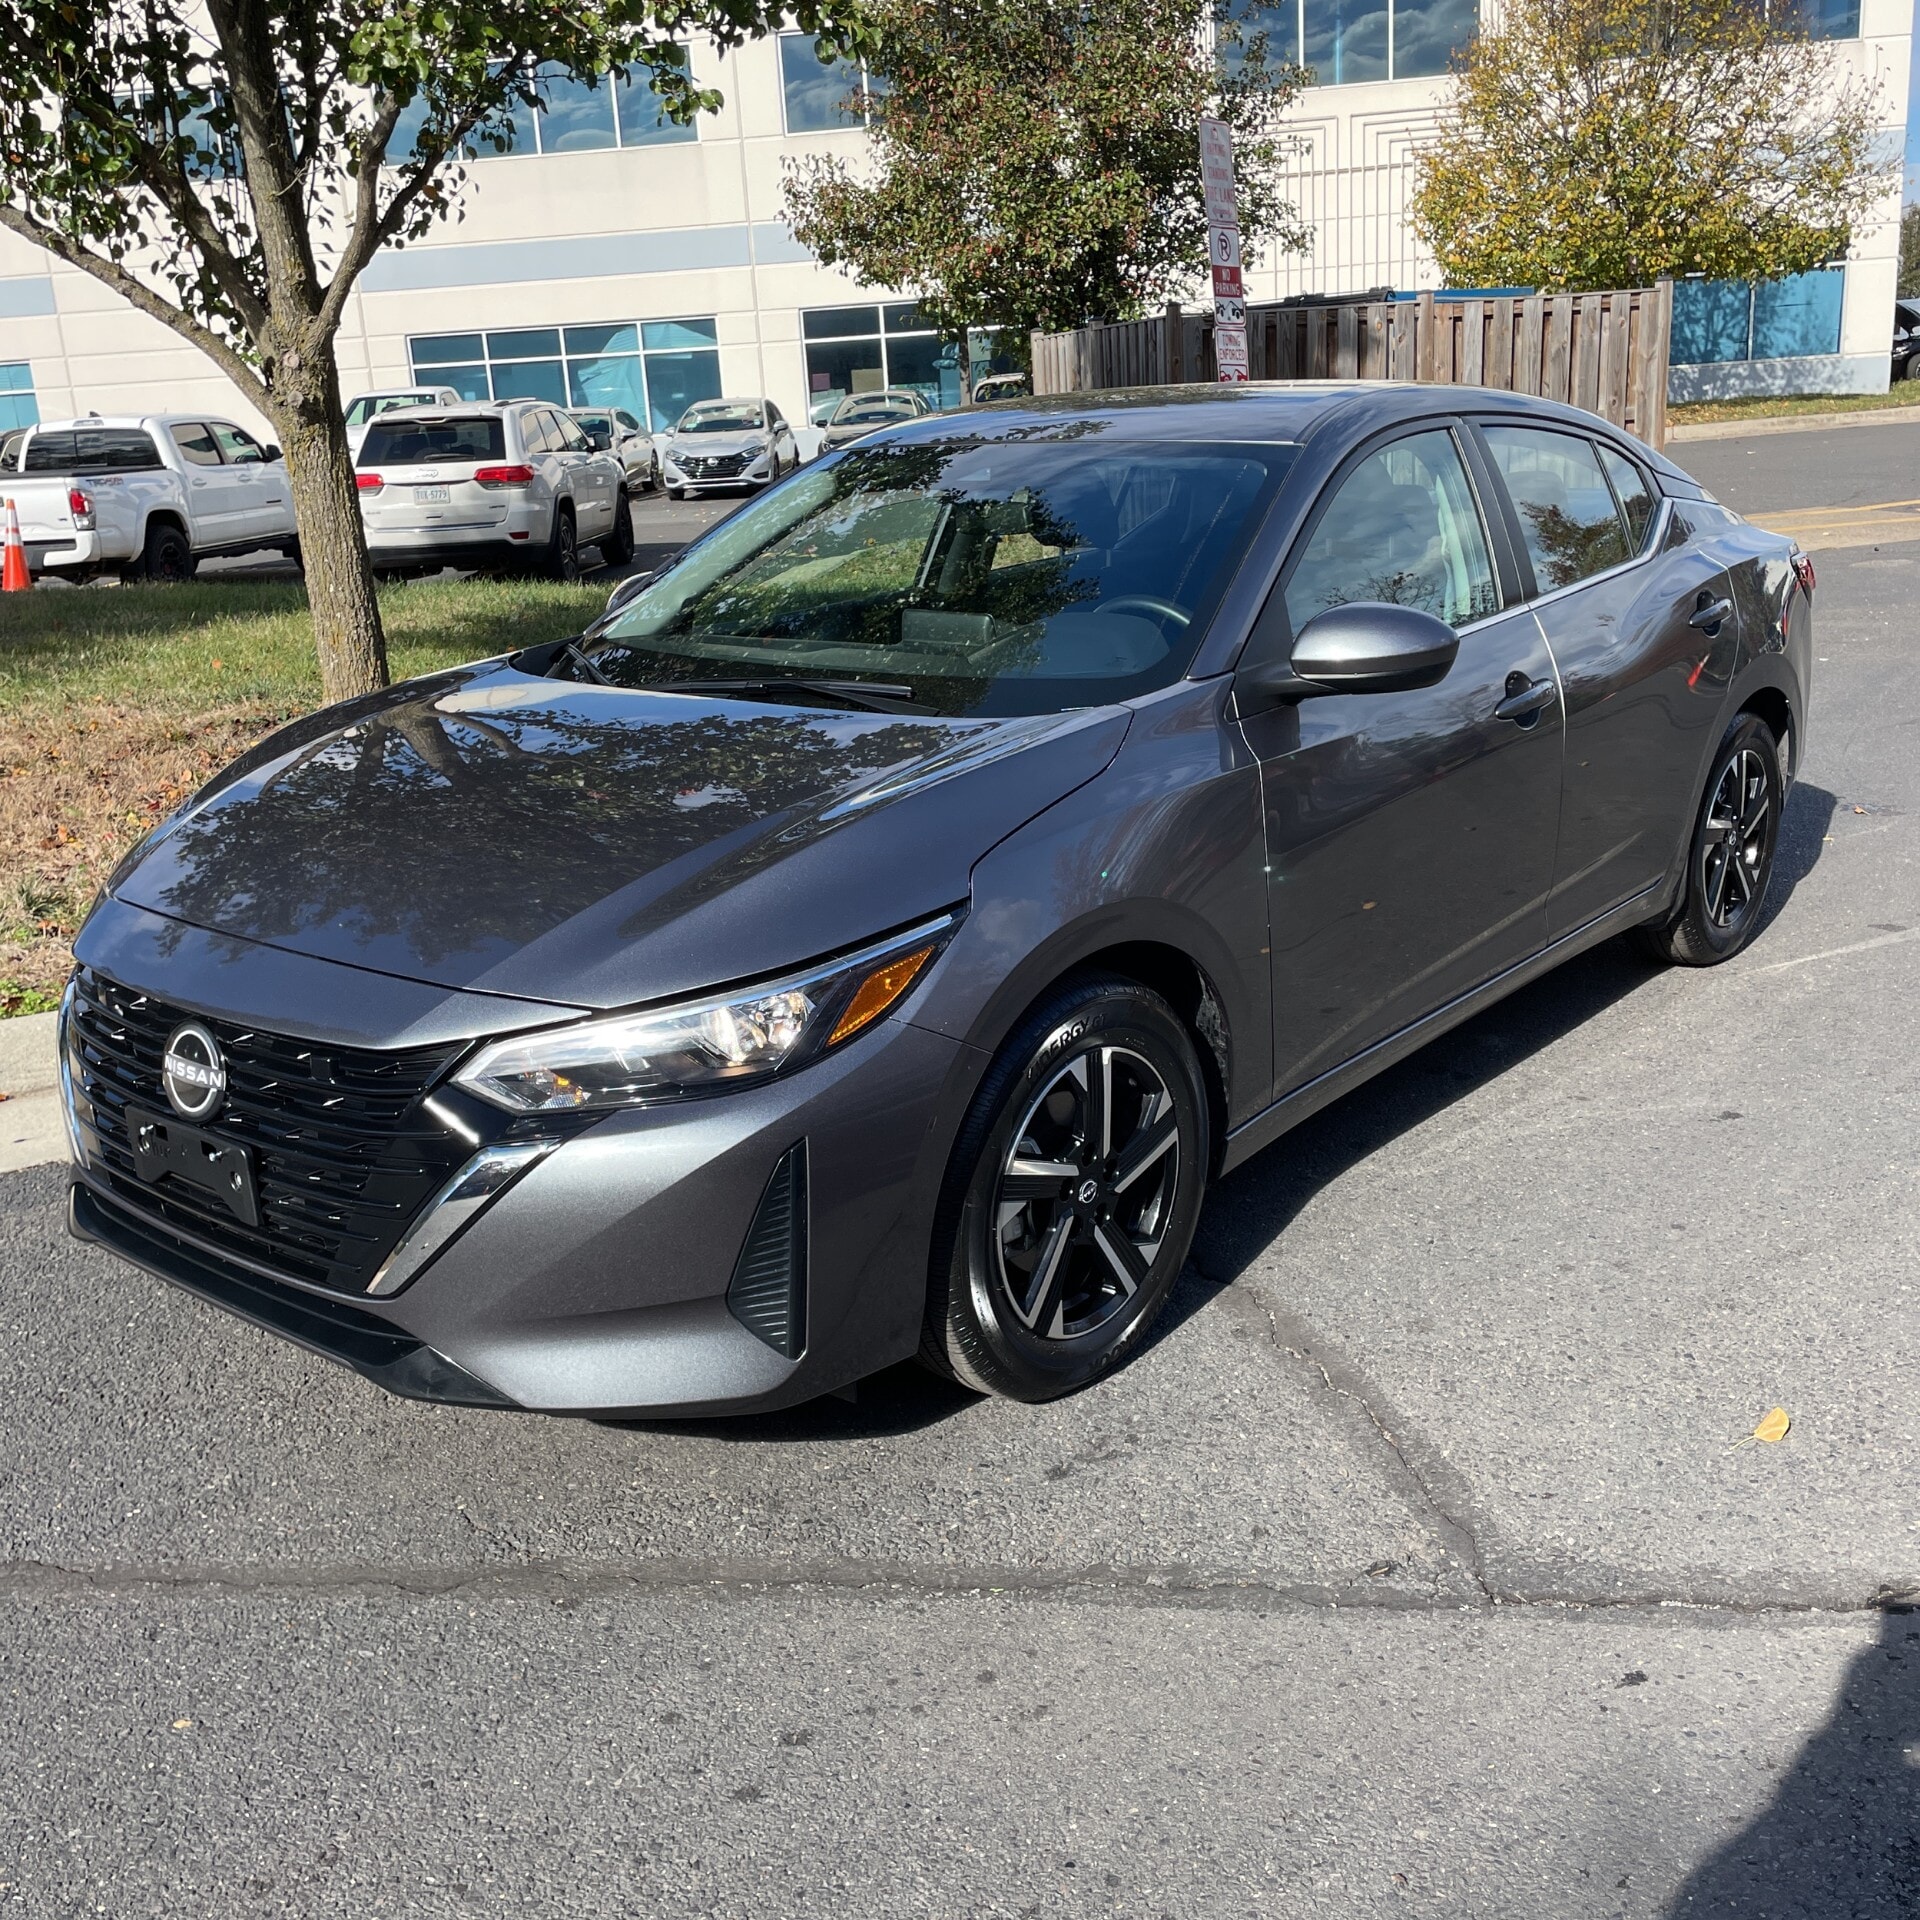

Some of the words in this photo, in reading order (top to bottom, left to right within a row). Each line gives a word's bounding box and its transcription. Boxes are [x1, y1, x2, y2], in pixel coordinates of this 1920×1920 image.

[1220, 187, 1236, 204] LANE
[1221, 268, 1231, 281] NO
[1215, 281, 1240, 296] PARKING
[1222, 333, 1240, 347] TOWING
[1219, 348, 1245, 361] ENFORCED
[165, 1054, 222, 1088] NISSAN
